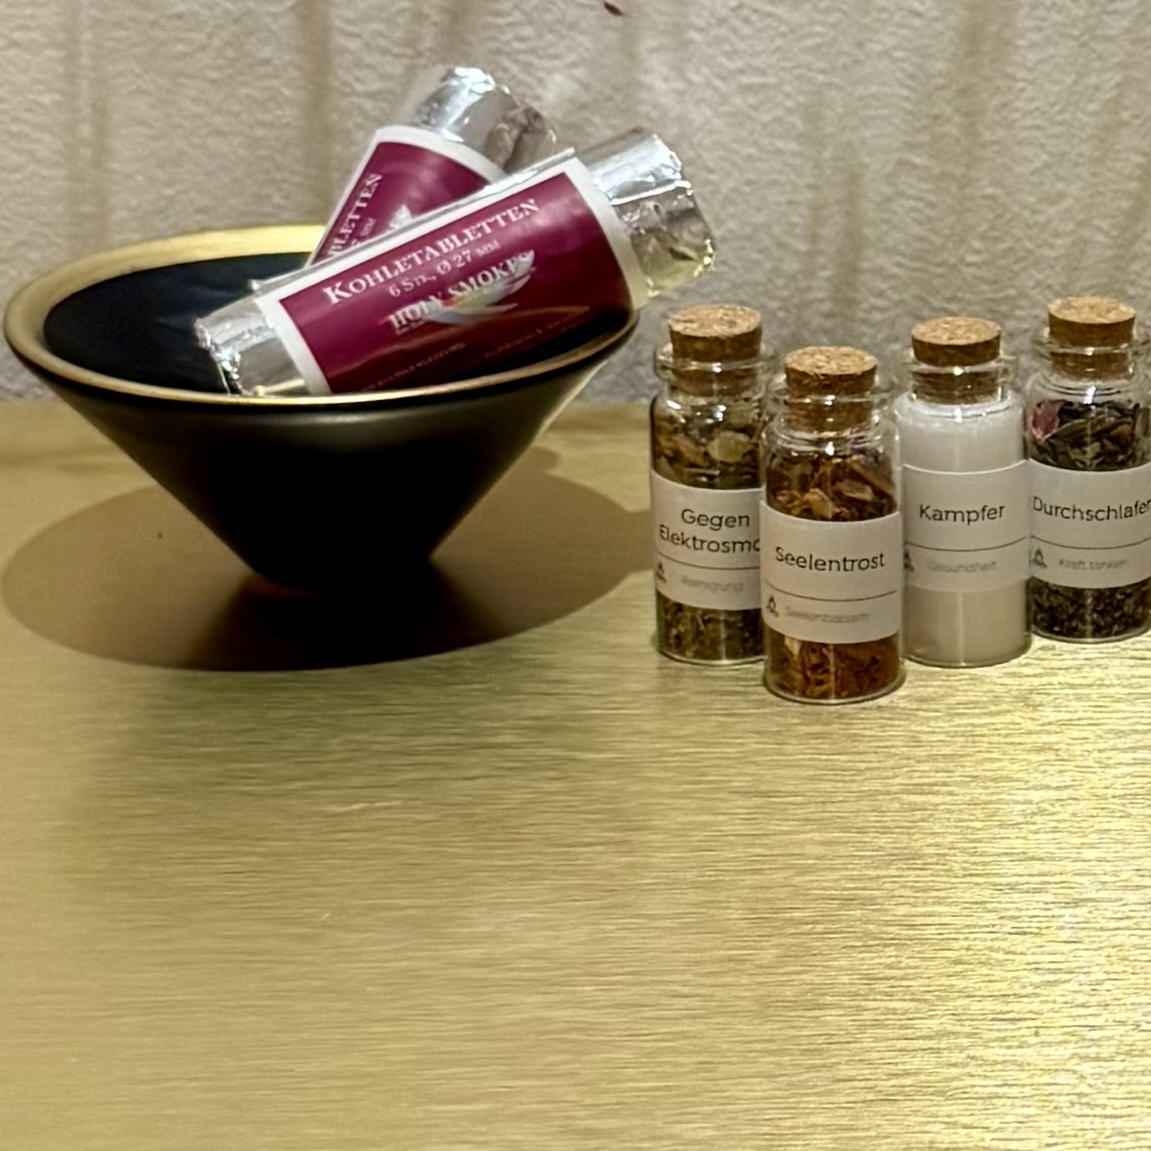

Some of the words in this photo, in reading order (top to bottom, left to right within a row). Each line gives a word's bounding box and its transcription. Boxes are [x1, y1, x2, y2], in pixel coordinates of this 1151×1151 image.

[322, 198, 540, 305] KOHLETABLETTEN
[455, 249, 473, 267] 27
[681, 509, 750, 531] Gegen
[919, 504, 1006, 526] Kampfer
[659, 523, 760, 553] Elektrosmo
[776, 546, 885, 572] Seelentrost
